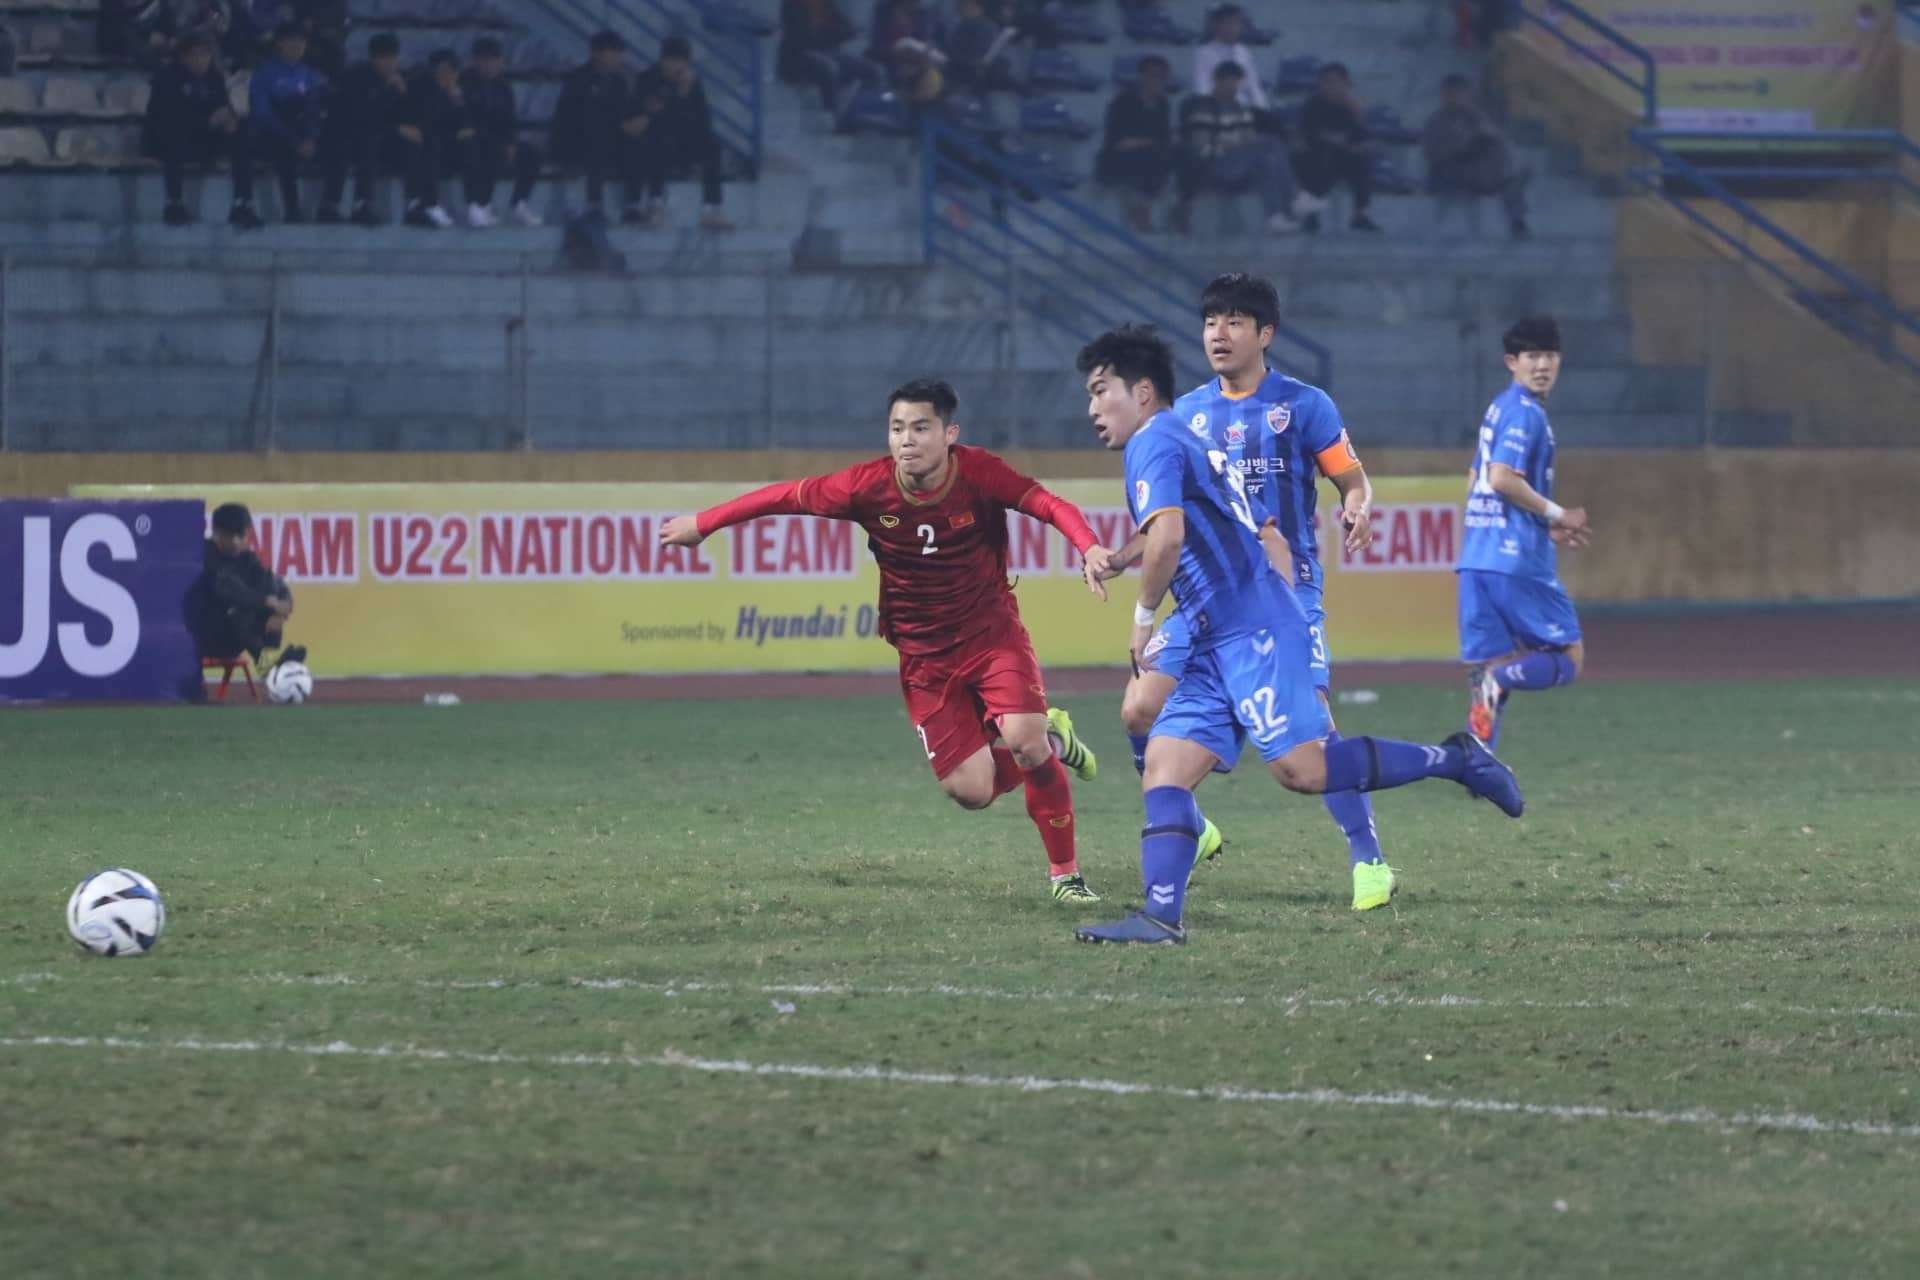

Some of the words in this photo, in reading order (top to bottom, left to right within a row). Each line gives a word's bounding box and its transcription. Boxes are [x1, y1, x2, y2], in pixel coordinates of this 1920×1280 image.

[373, 516, 467, 576] U22
[917, 524, 939, 555] 2
[621, 622, 704, 643] Sponsored
[707, 621, 726, 643] by
[736, 605, 848, 648] Hyundai
[1241, 687, 1287, 737] 32
